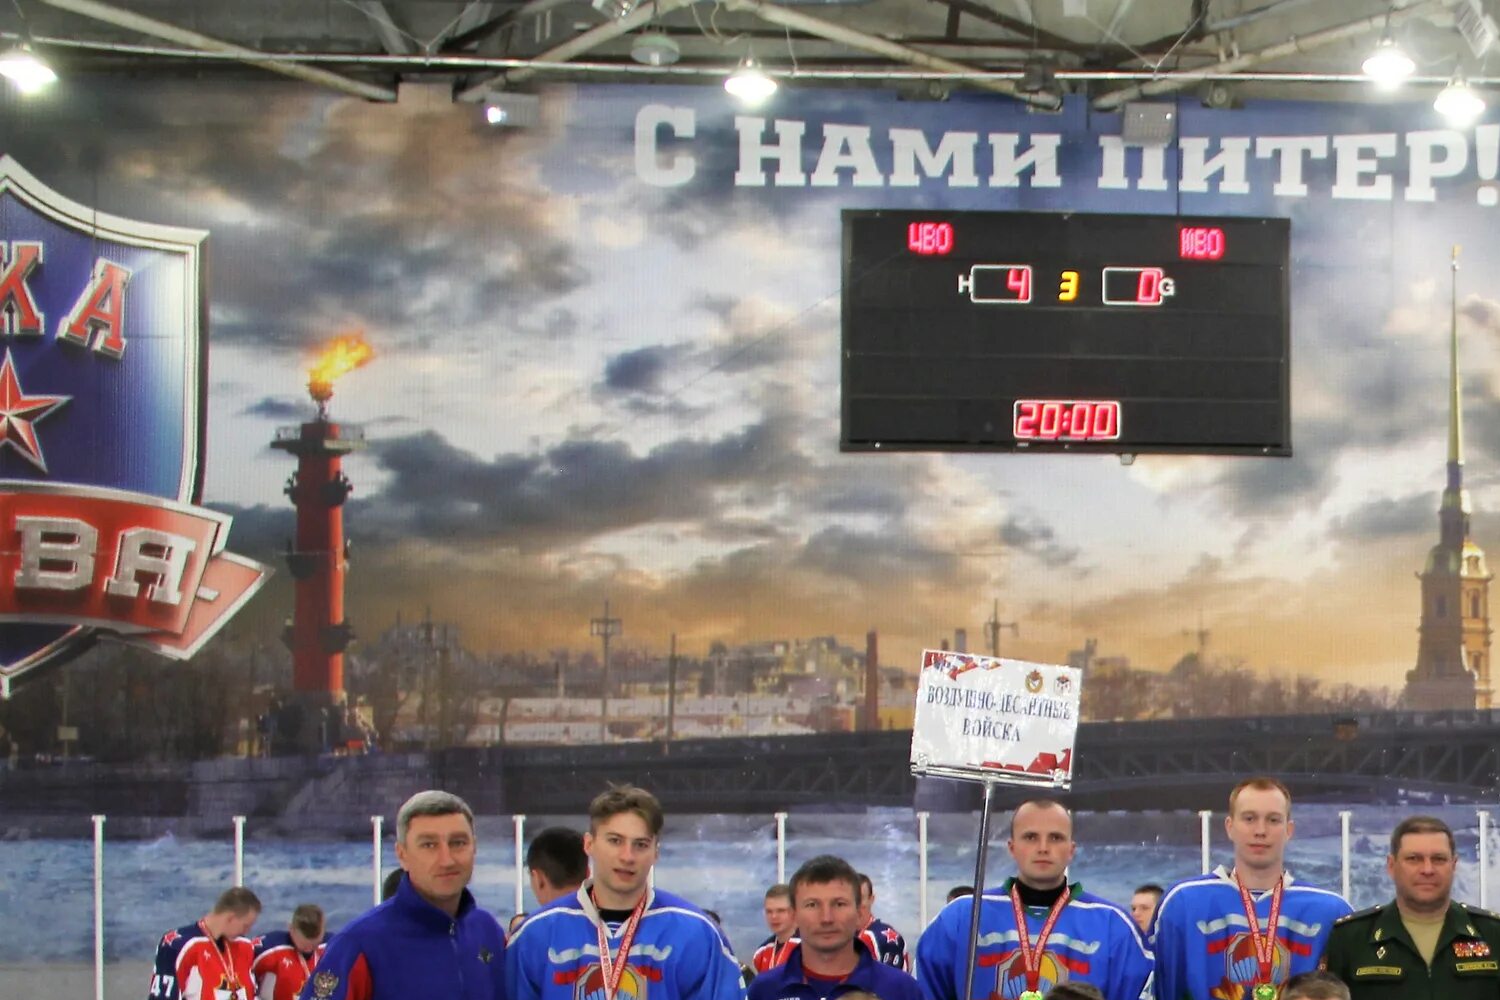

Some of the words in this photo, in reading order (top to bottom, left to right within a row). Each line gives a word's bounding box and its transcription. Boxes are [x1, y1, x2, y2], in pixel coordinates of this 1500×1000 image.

[635, 104, 698, 186] С
[733, 115, 1062, 189] НАМИ
[0, 239, 132, 360] КА
[958, 275, 972, 293] H
[1007, 268, 1030, 301] 4
[1058, 270, 1080, 301] 3
[1137, 268, 1162, 302] 0
[1159, 278, 1175, 297] G
[1016, 403, 1118, 438] 20:00
[13, 514, 198, 606] ВА
[963, 716, 1021, 742] ВОЙСКА
[149, 974, 176, 998] 47
